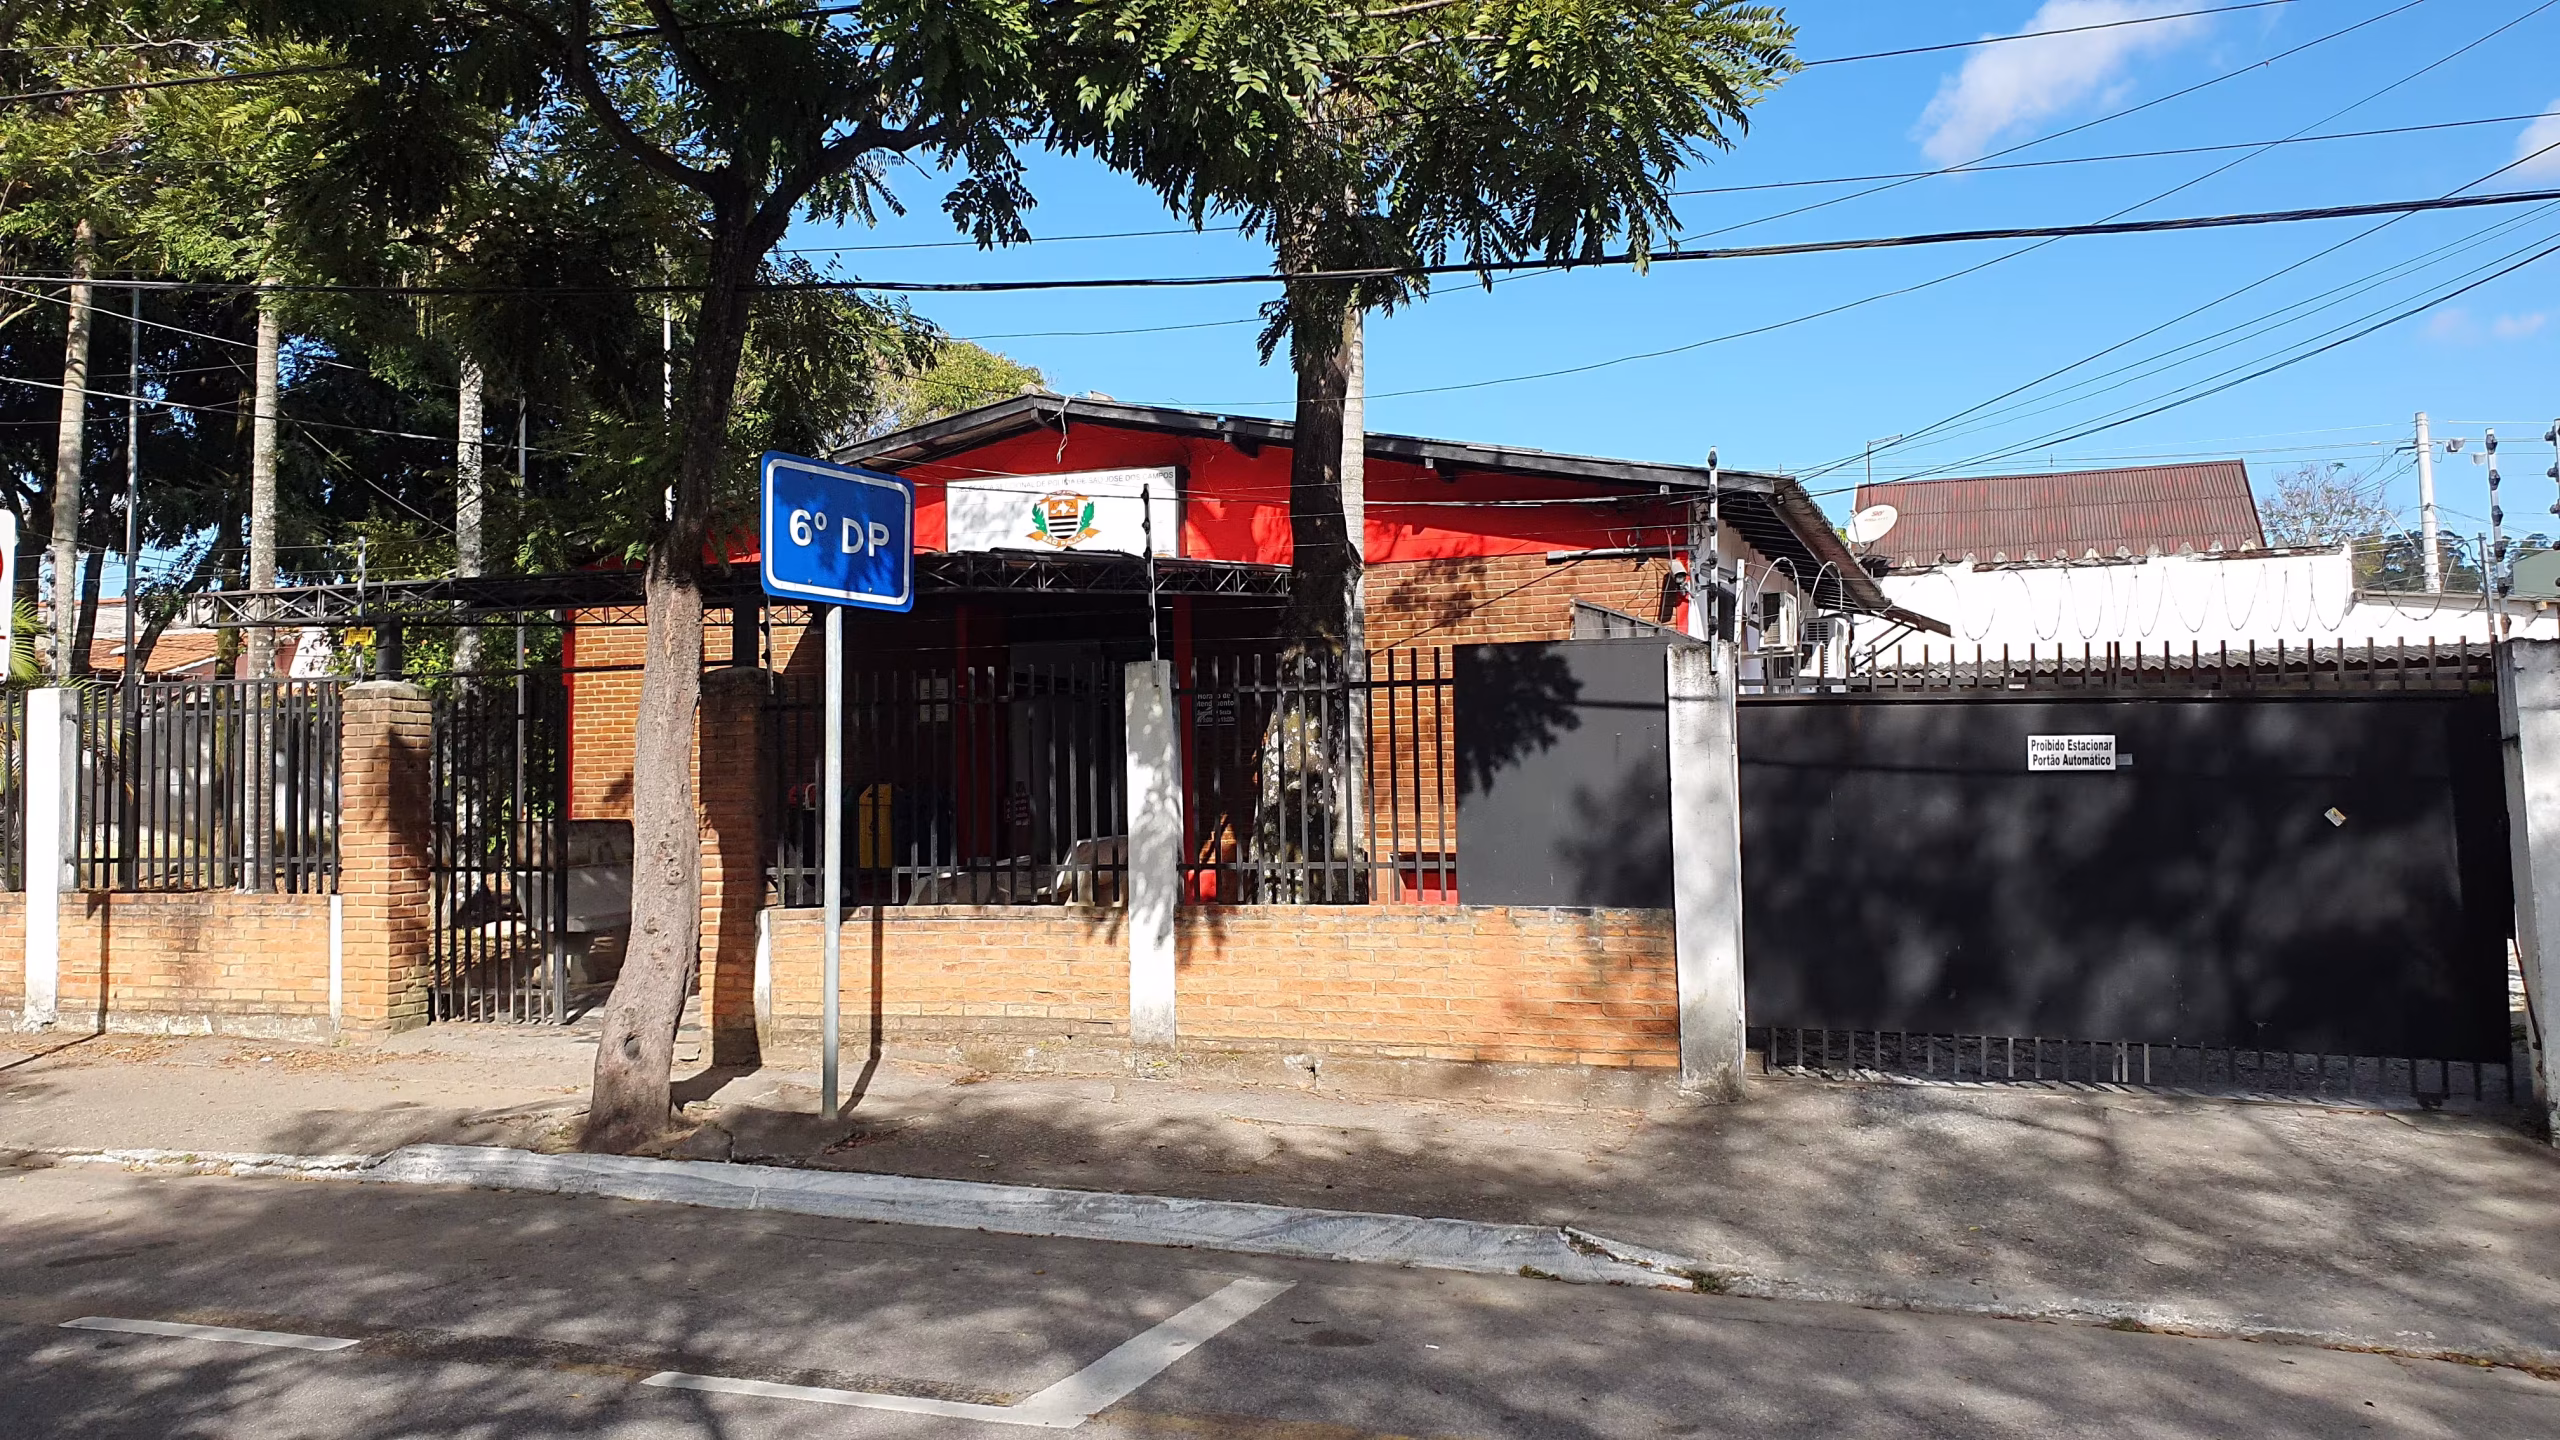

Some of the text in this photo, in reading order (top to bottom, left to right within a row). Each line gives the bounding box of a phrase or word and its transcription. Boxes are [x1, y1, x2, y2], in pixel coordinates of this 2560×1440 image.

[1036, 480, 1046, 488] DE
[1125, 473, 1141, 482] DOS
[1142, 471, 1174, 480] CAMPOS
[842, 517, 890, 557] DP
[1060, 533, 1087, 546] PAULO
[2031, 739, 2113, 751] Proibido Estacionar
[2032, 753, 2111, 766] Portão Automático
